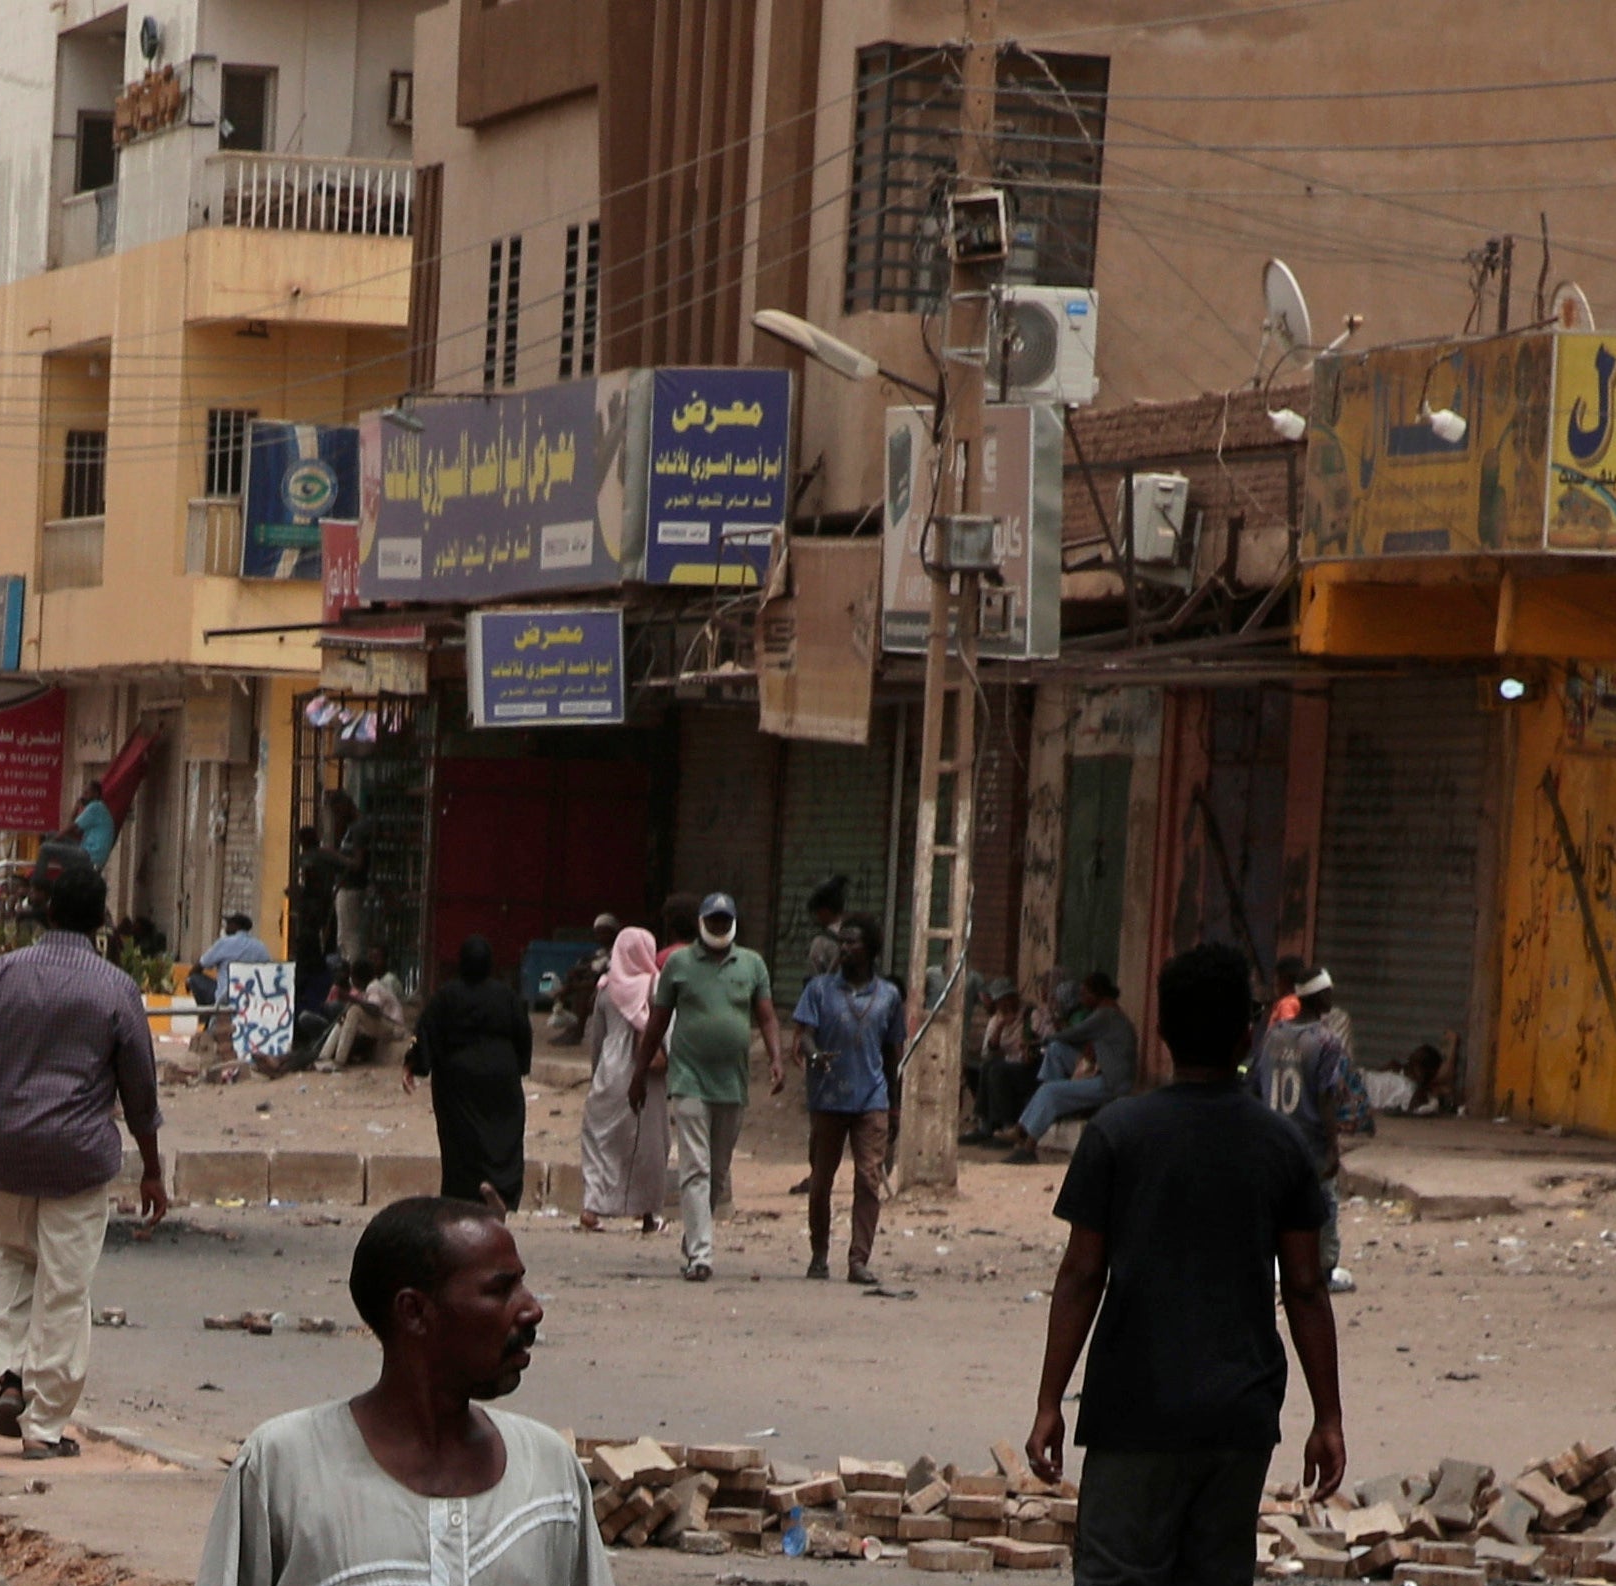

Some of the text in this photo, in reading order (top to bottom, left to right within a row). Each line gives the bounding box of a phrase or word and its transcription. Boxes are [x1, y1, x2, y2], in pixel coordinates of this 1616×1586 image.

[672, 391, 763, 433] معرض
[529, 414, 576, 503] معرض
[691, 452, 732, 484] السوري
[734, 446, 762, 475] أحمد
[514, 620, 583, 649] معرض
[10, 752, 59, 766] surgery
[1270, 1068, 1301, 1115] 10
